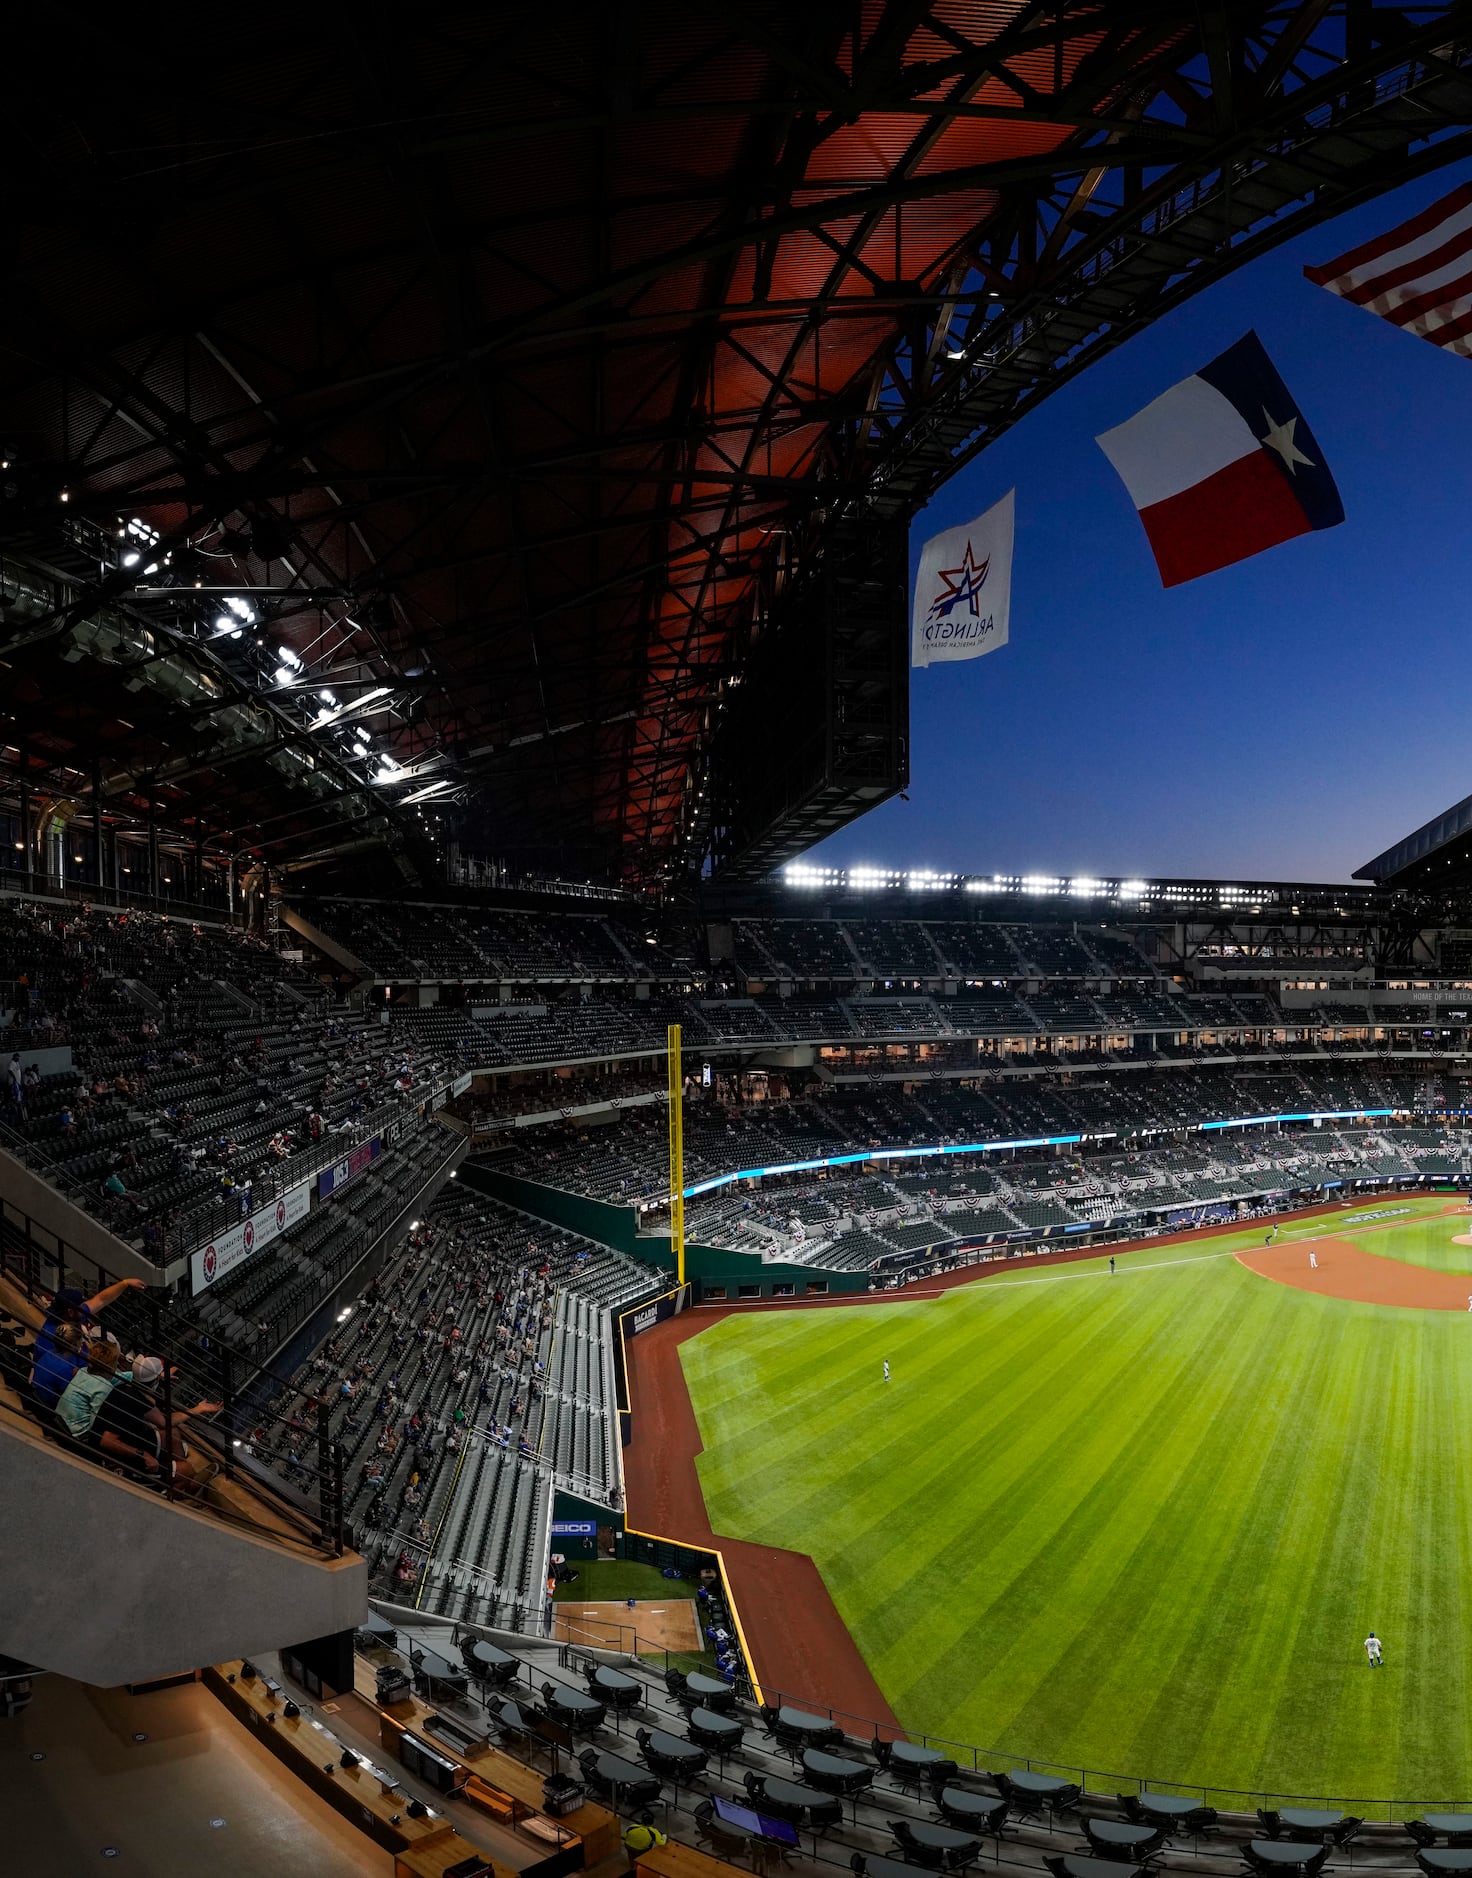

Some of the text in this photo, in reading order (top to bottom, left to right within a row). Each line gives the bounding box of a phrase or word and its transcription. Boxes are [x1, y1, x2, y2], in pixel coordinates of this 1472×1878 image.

[1413, 992, 1432, 1001] HOME
[1435, 992, 1442, 1001] OF
[1445, 992, 1457, 1001] THE
[218, 1234, 243, 1254] FOUNDATION
[552, 1524, 591, 1533] EICO
